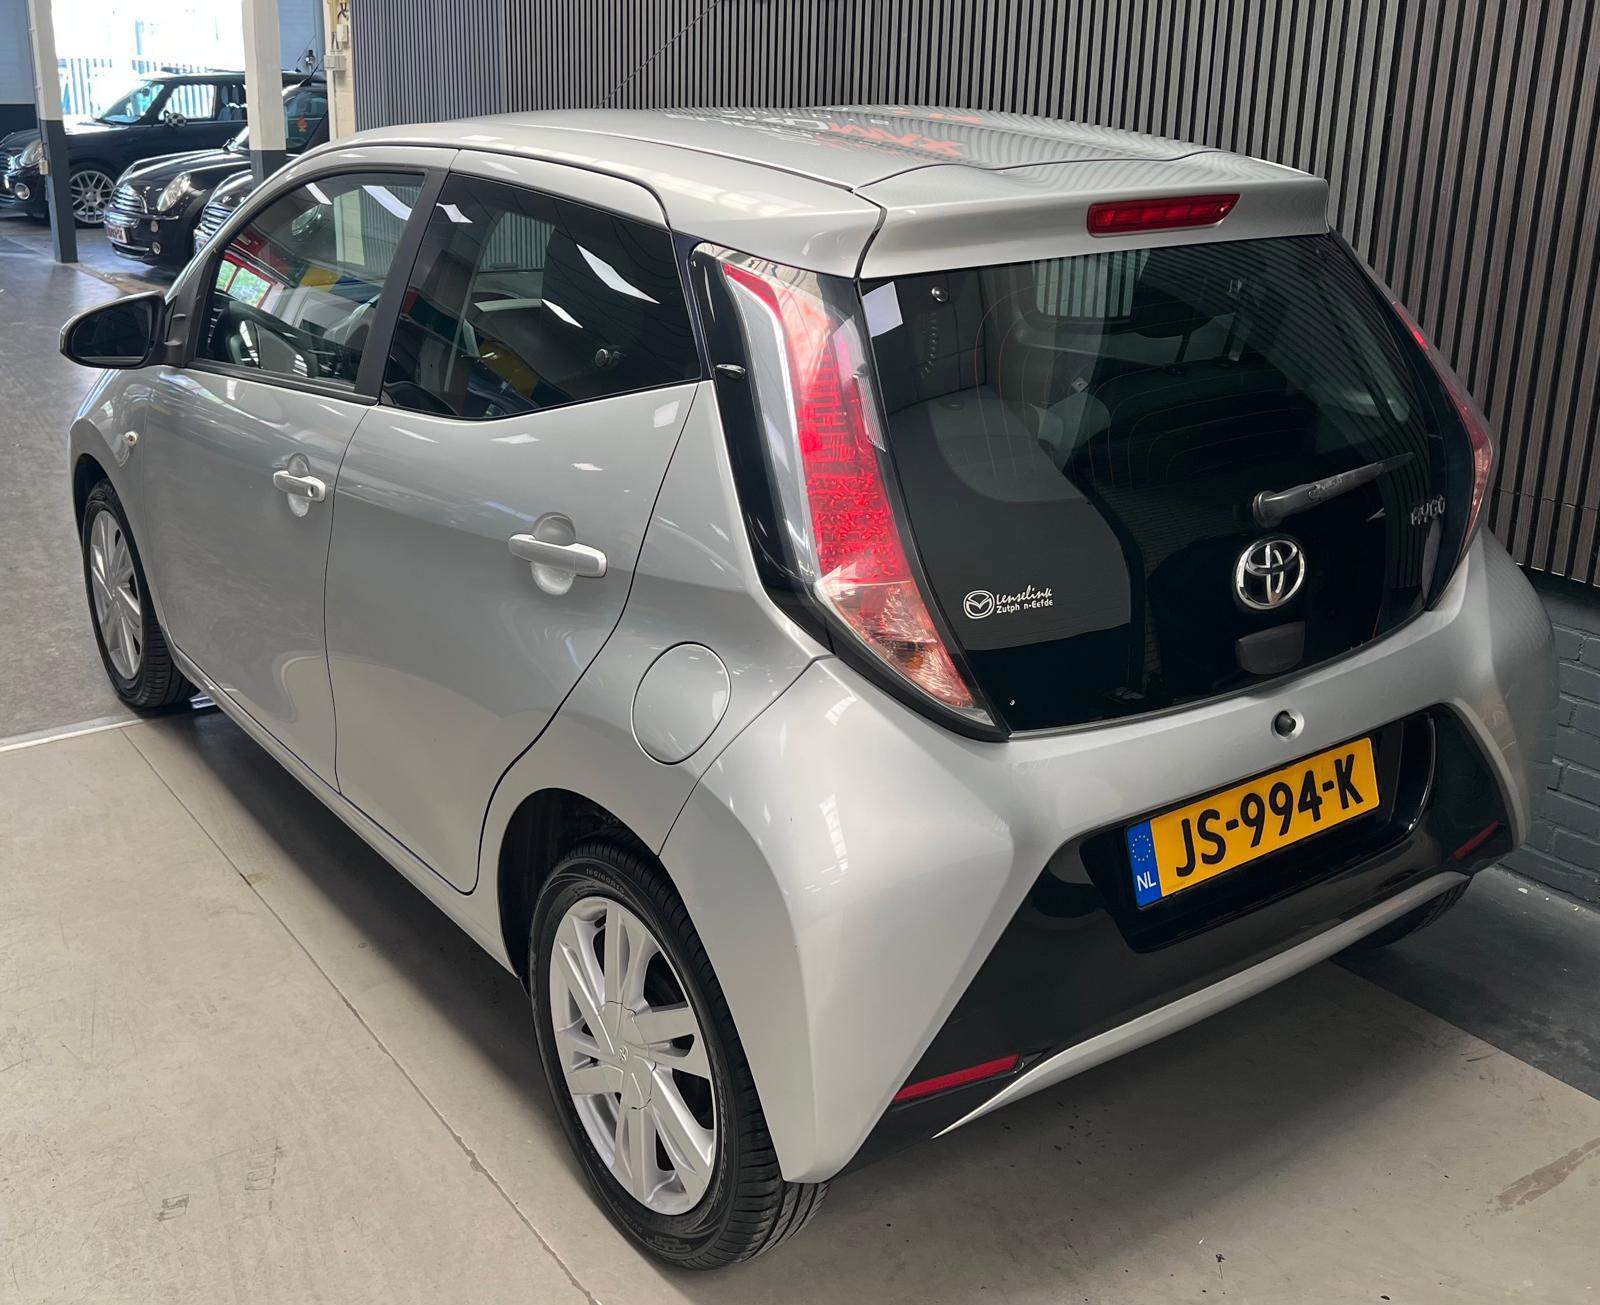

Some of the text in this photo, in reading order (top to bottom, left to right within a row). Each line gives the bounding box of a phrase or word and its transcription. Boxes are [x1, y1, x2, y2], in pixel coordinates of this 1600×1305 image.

[996, 585, 1053, 605] Lenselink
[1176, 754, 1364, 877] JS-994-K
[1136, 871, 1157, 892] NL
